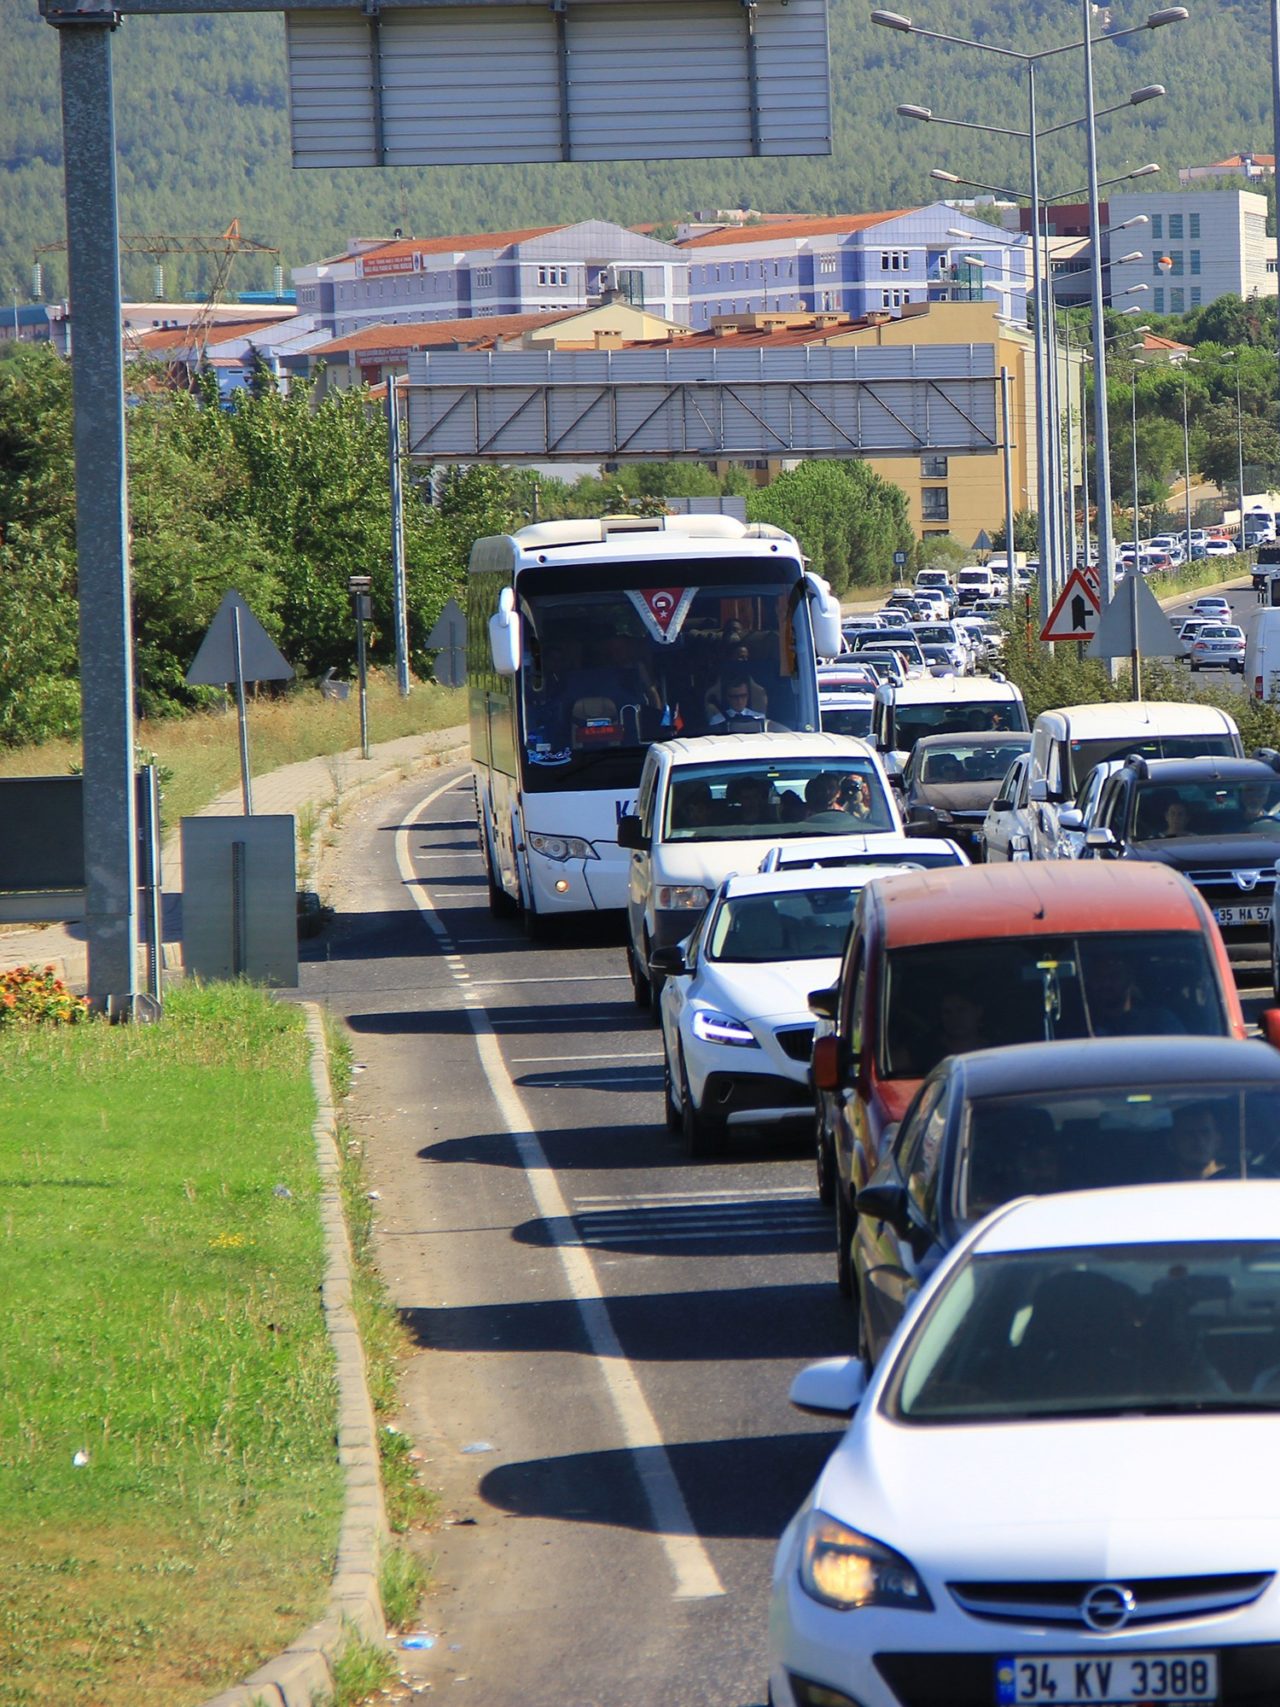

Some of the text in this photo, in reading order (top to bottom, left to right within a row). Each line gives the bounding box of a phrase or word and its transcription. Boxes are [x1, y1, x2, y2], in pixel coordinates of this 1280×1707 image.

[1220, 909, 1233, 921] 35
[1239, 908, 1253, 920] HA
[1020, 1660, 1208, 1699] 34 KV 3388
